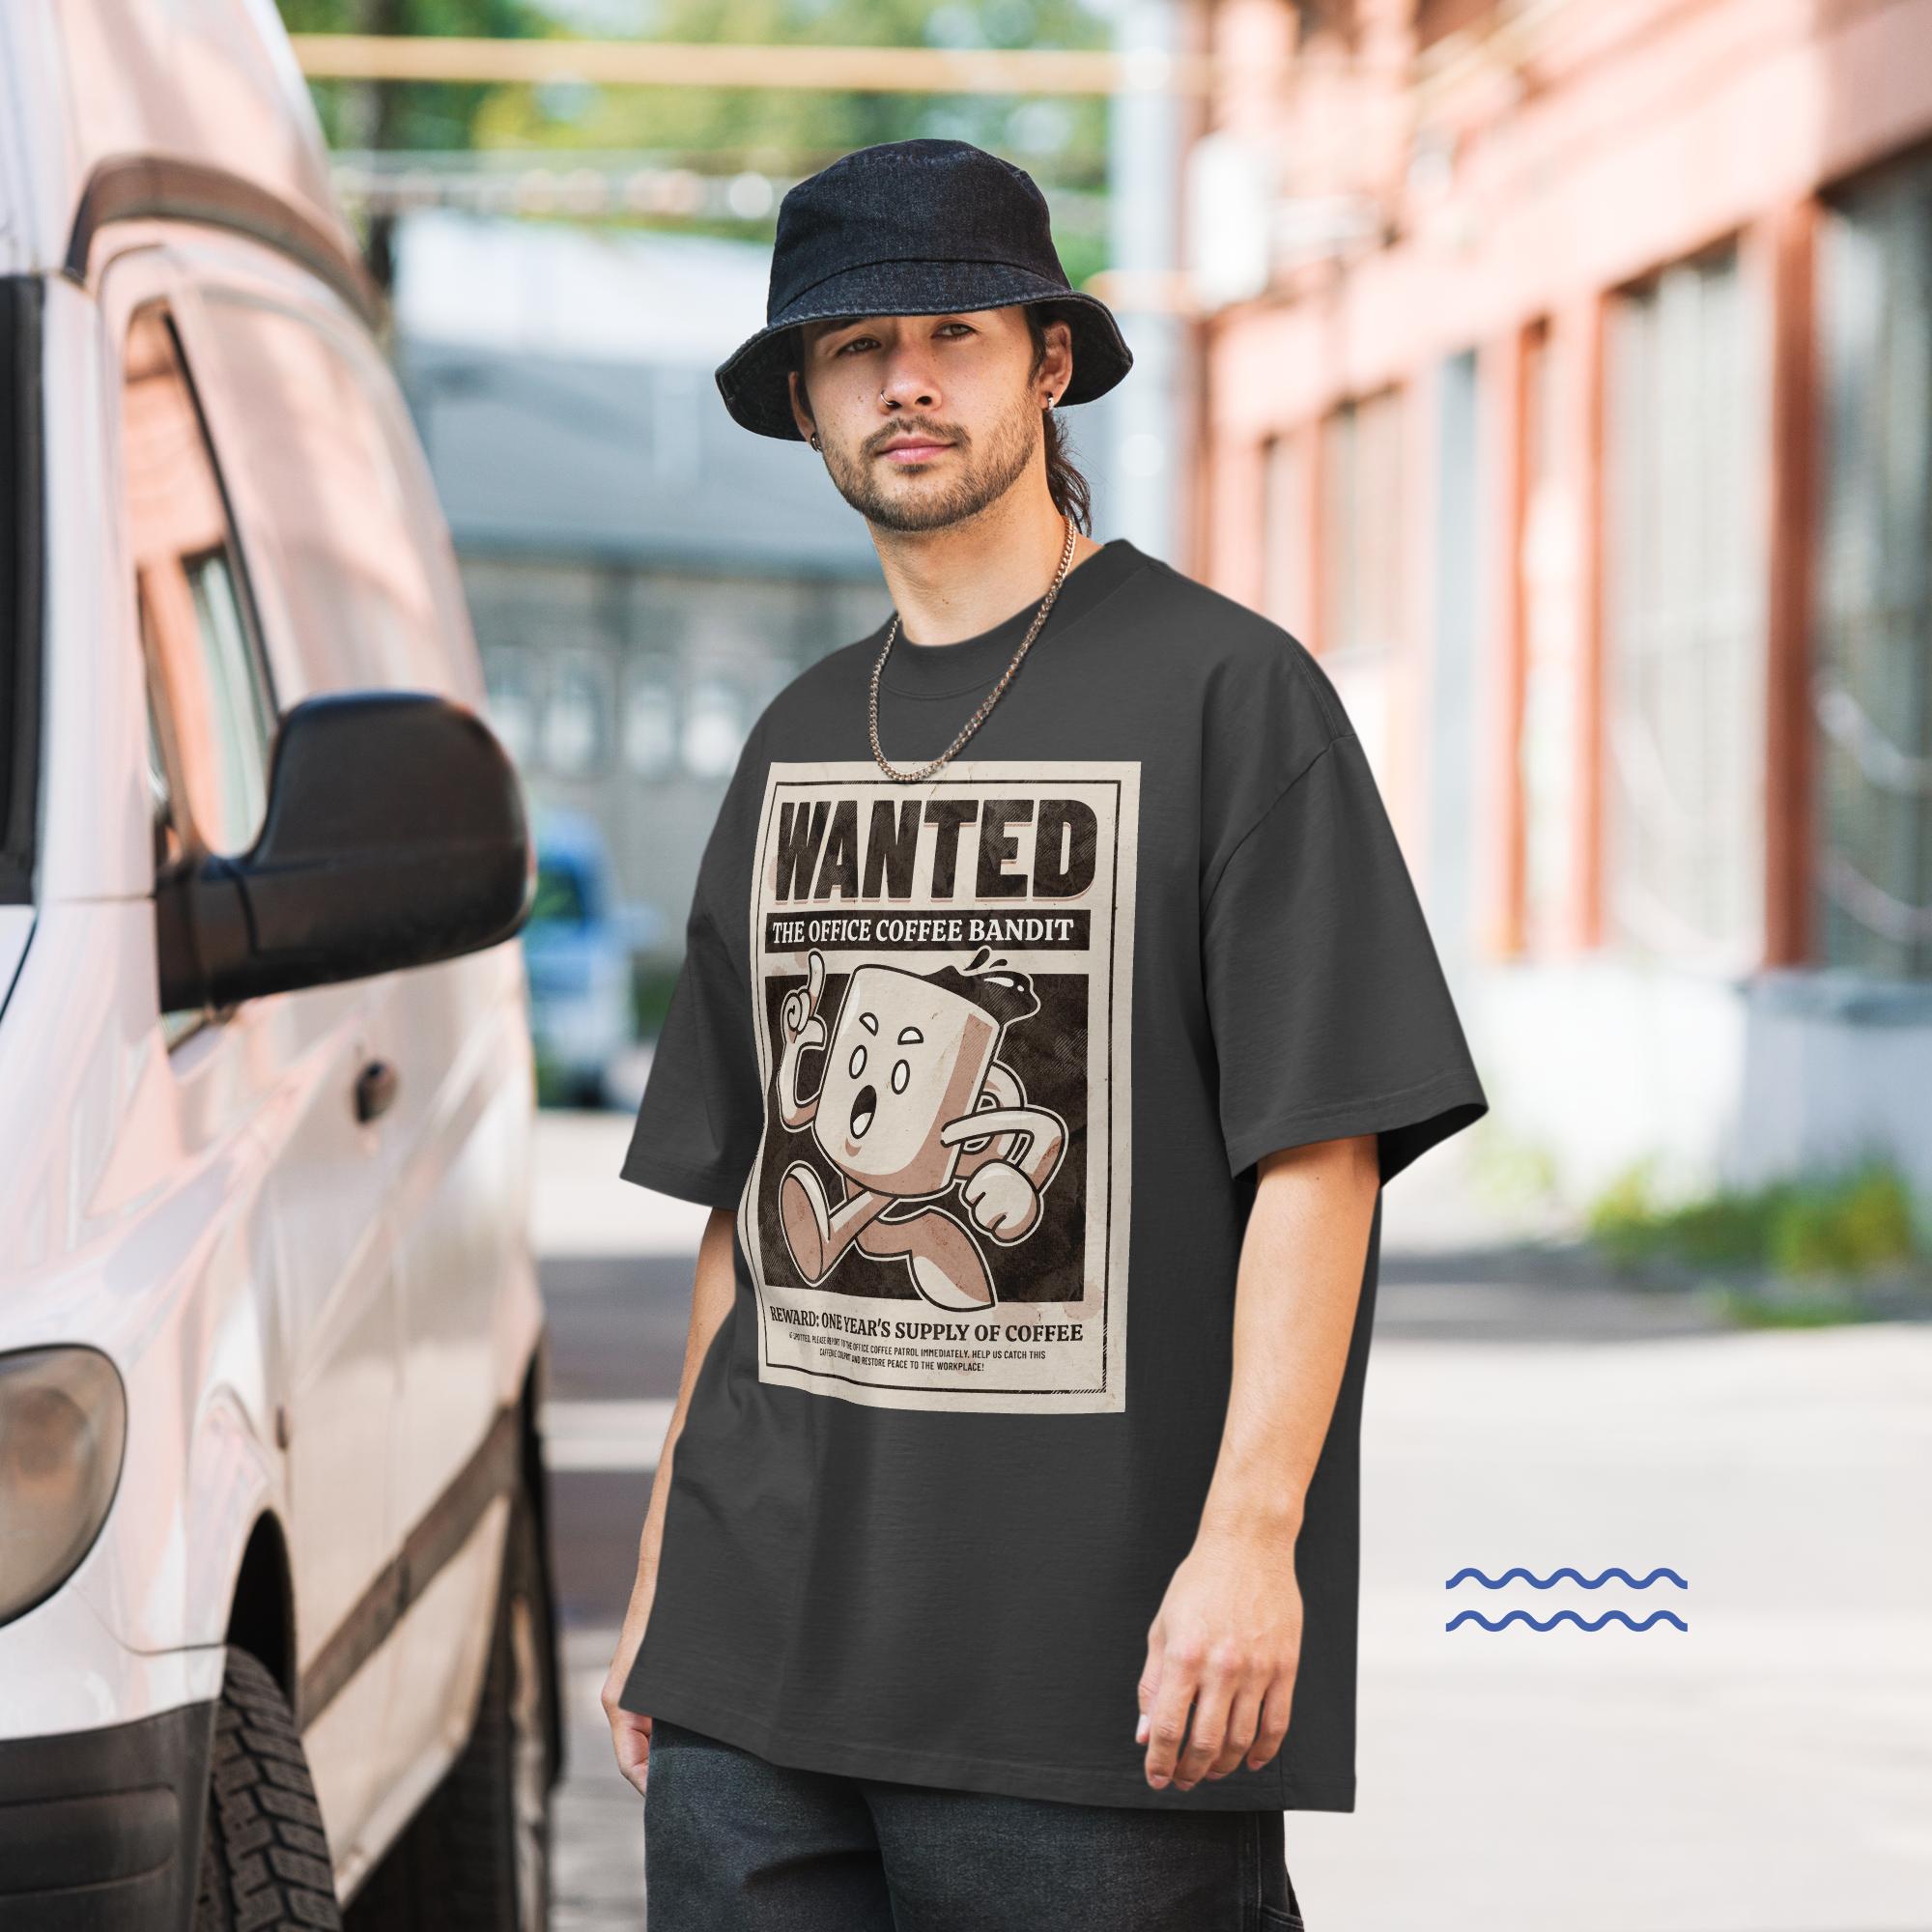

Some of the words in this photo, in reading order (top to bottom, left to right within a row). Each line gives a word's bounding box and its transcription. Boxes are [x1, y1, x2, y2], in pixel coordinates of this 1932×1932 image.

[774, 799, 1097, 903] WANTED
[772, 921, 805, 944] THE
[808, 919, 871, 943] OFFICE
[875, 919, 963, 943] COFFEE
[969, 918, 1074, 942] BANDIT
[769, 1305, 819, 1328] REWARD:
[821, 1312, 843, 1331] ONE
[843, 1316, 892, 1339] YEAR'S
[895, 1321, 970, 1342] SUPPLY
[974, 1324, 1001, 1342] OF
[1006, 1323, 1084, 1342] COFFEE
[811, 1335, 827, 1345] PLEASE
[852, 1343, 869, 1353] OFFICE
[870, 1345, 893, 1355] COFFEE
[894, 1347, 919, 1357] PATROL
[972, 1350, 992, 1359] HELP
[993, 1350, 1002, 1360] US
[1004, 1350, 1027, 1360] CATCH
[1029, 1350, 1046, 1360] THIS
[851, 1354, 861, 1364] AND
[861, 1356, 886, 1367] RESTORE
[887, 1359, 908, 1369] PEACE
[910, 1360, 919, 1370] TO
[922, 1361, 935, 1371] THE
[936, 1361, 984, 1372] WORKPLACE!
